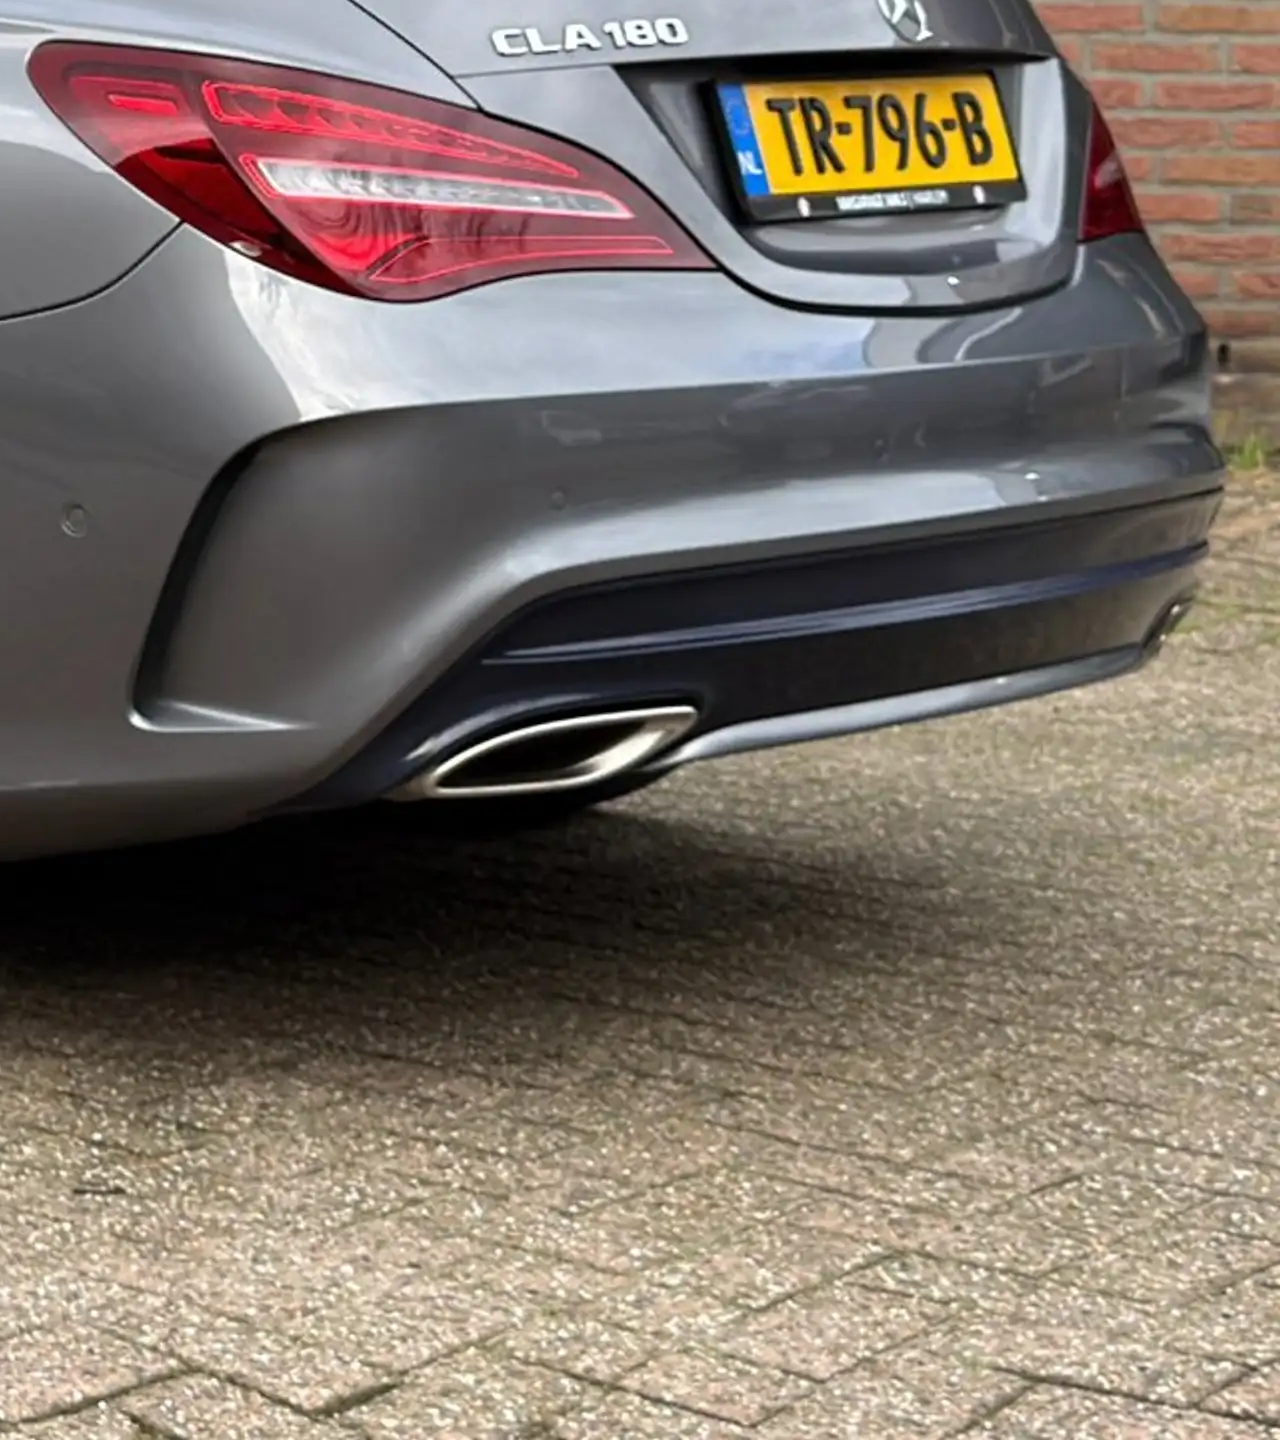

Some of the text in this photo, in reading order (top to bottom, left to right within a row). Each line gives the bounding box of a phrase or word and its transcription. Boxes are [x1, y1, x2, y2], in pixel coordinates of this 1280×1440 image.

[491, 17, 689, 56] CLA 180
[765, 91, 993, 176] TR-796-B
